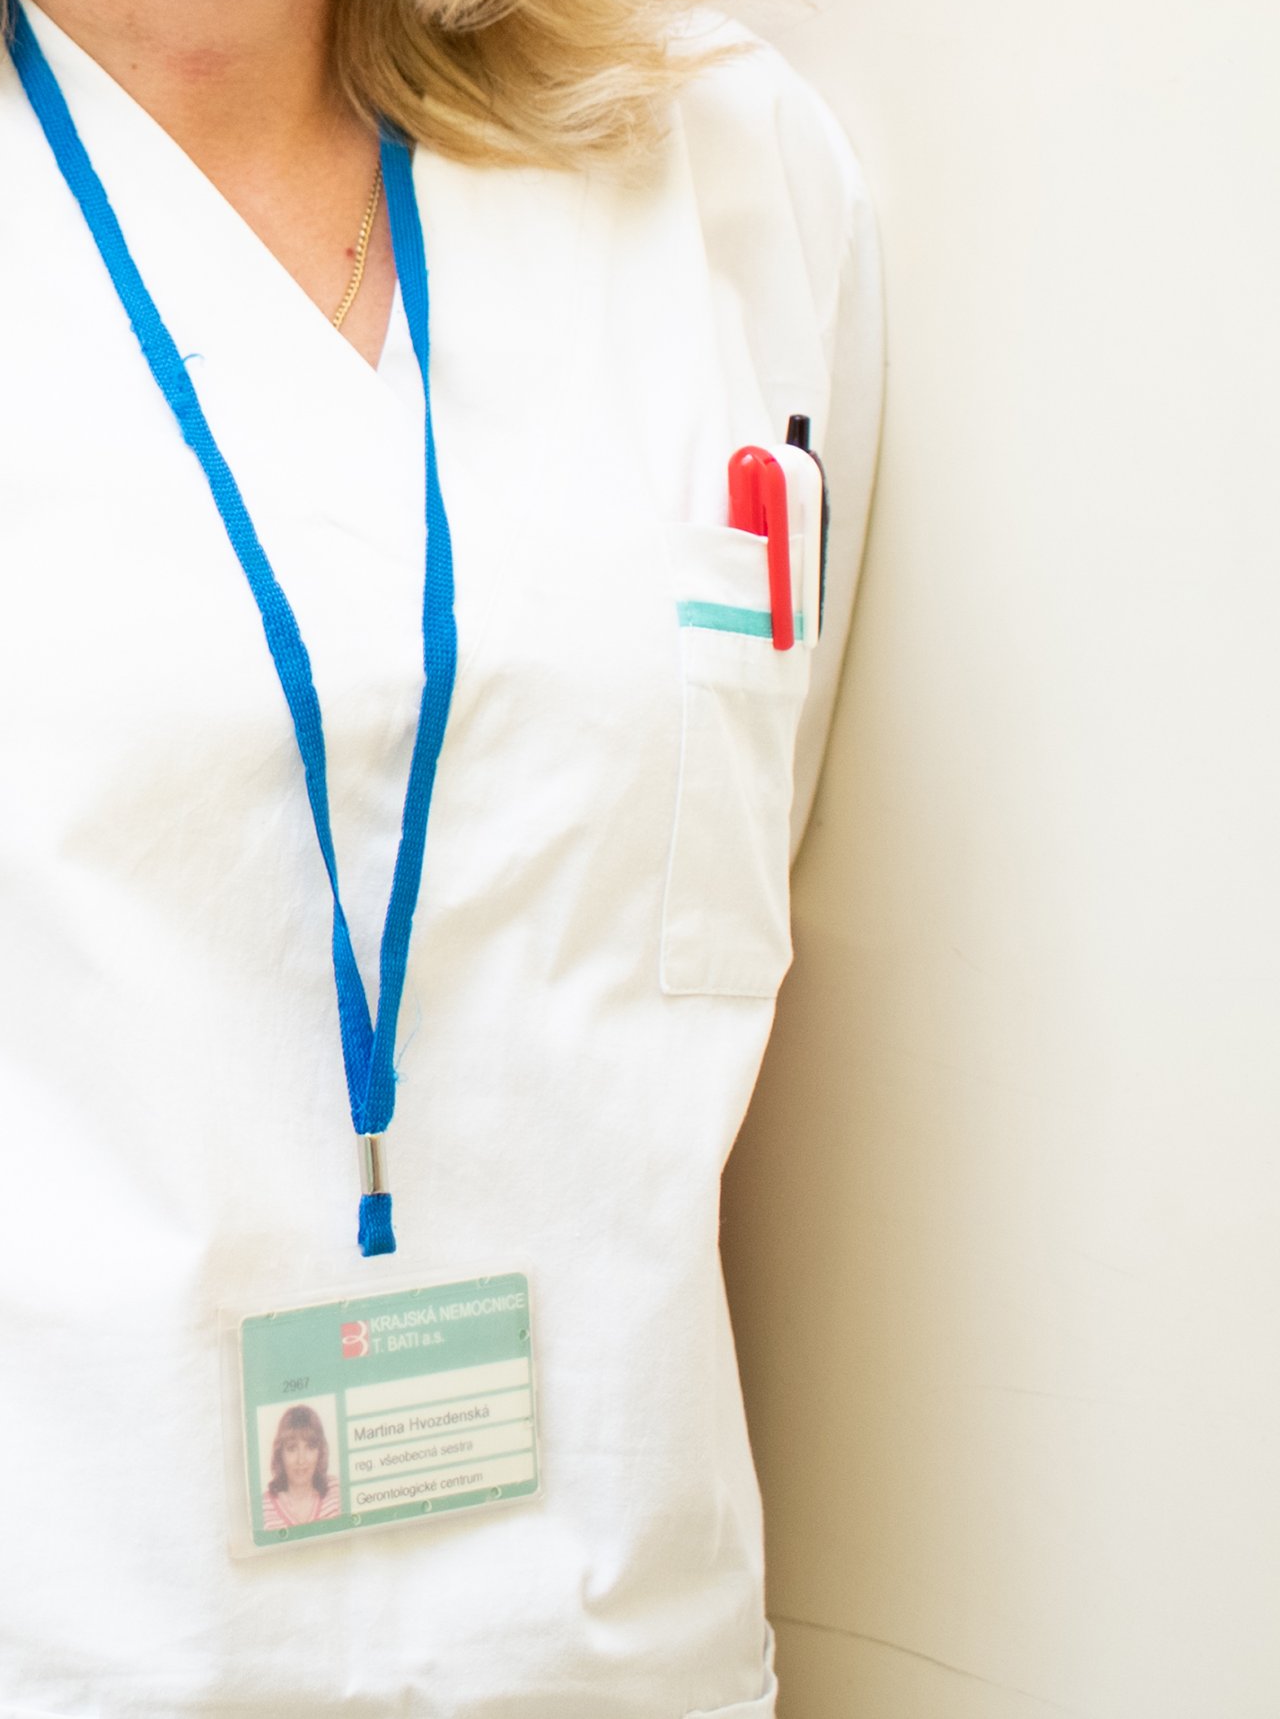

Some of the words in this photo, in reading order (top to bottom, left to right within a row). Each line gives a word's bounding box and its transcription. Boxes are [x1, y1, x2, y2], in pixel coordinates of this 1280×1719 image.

[370, 1305, 437, 1332] KRAJSKÁ
[440, 1292, 525, 1321] NEMOCNICE
[354, 1423, 405, 1442] Martina
[409, 1404, 490, 1430] Hvozdenská
[440, 1440, 473, 1456] sestra
[356, 1480, 437, 1505] Gerontologické
[440, 1471, 483, 1490] centrum
